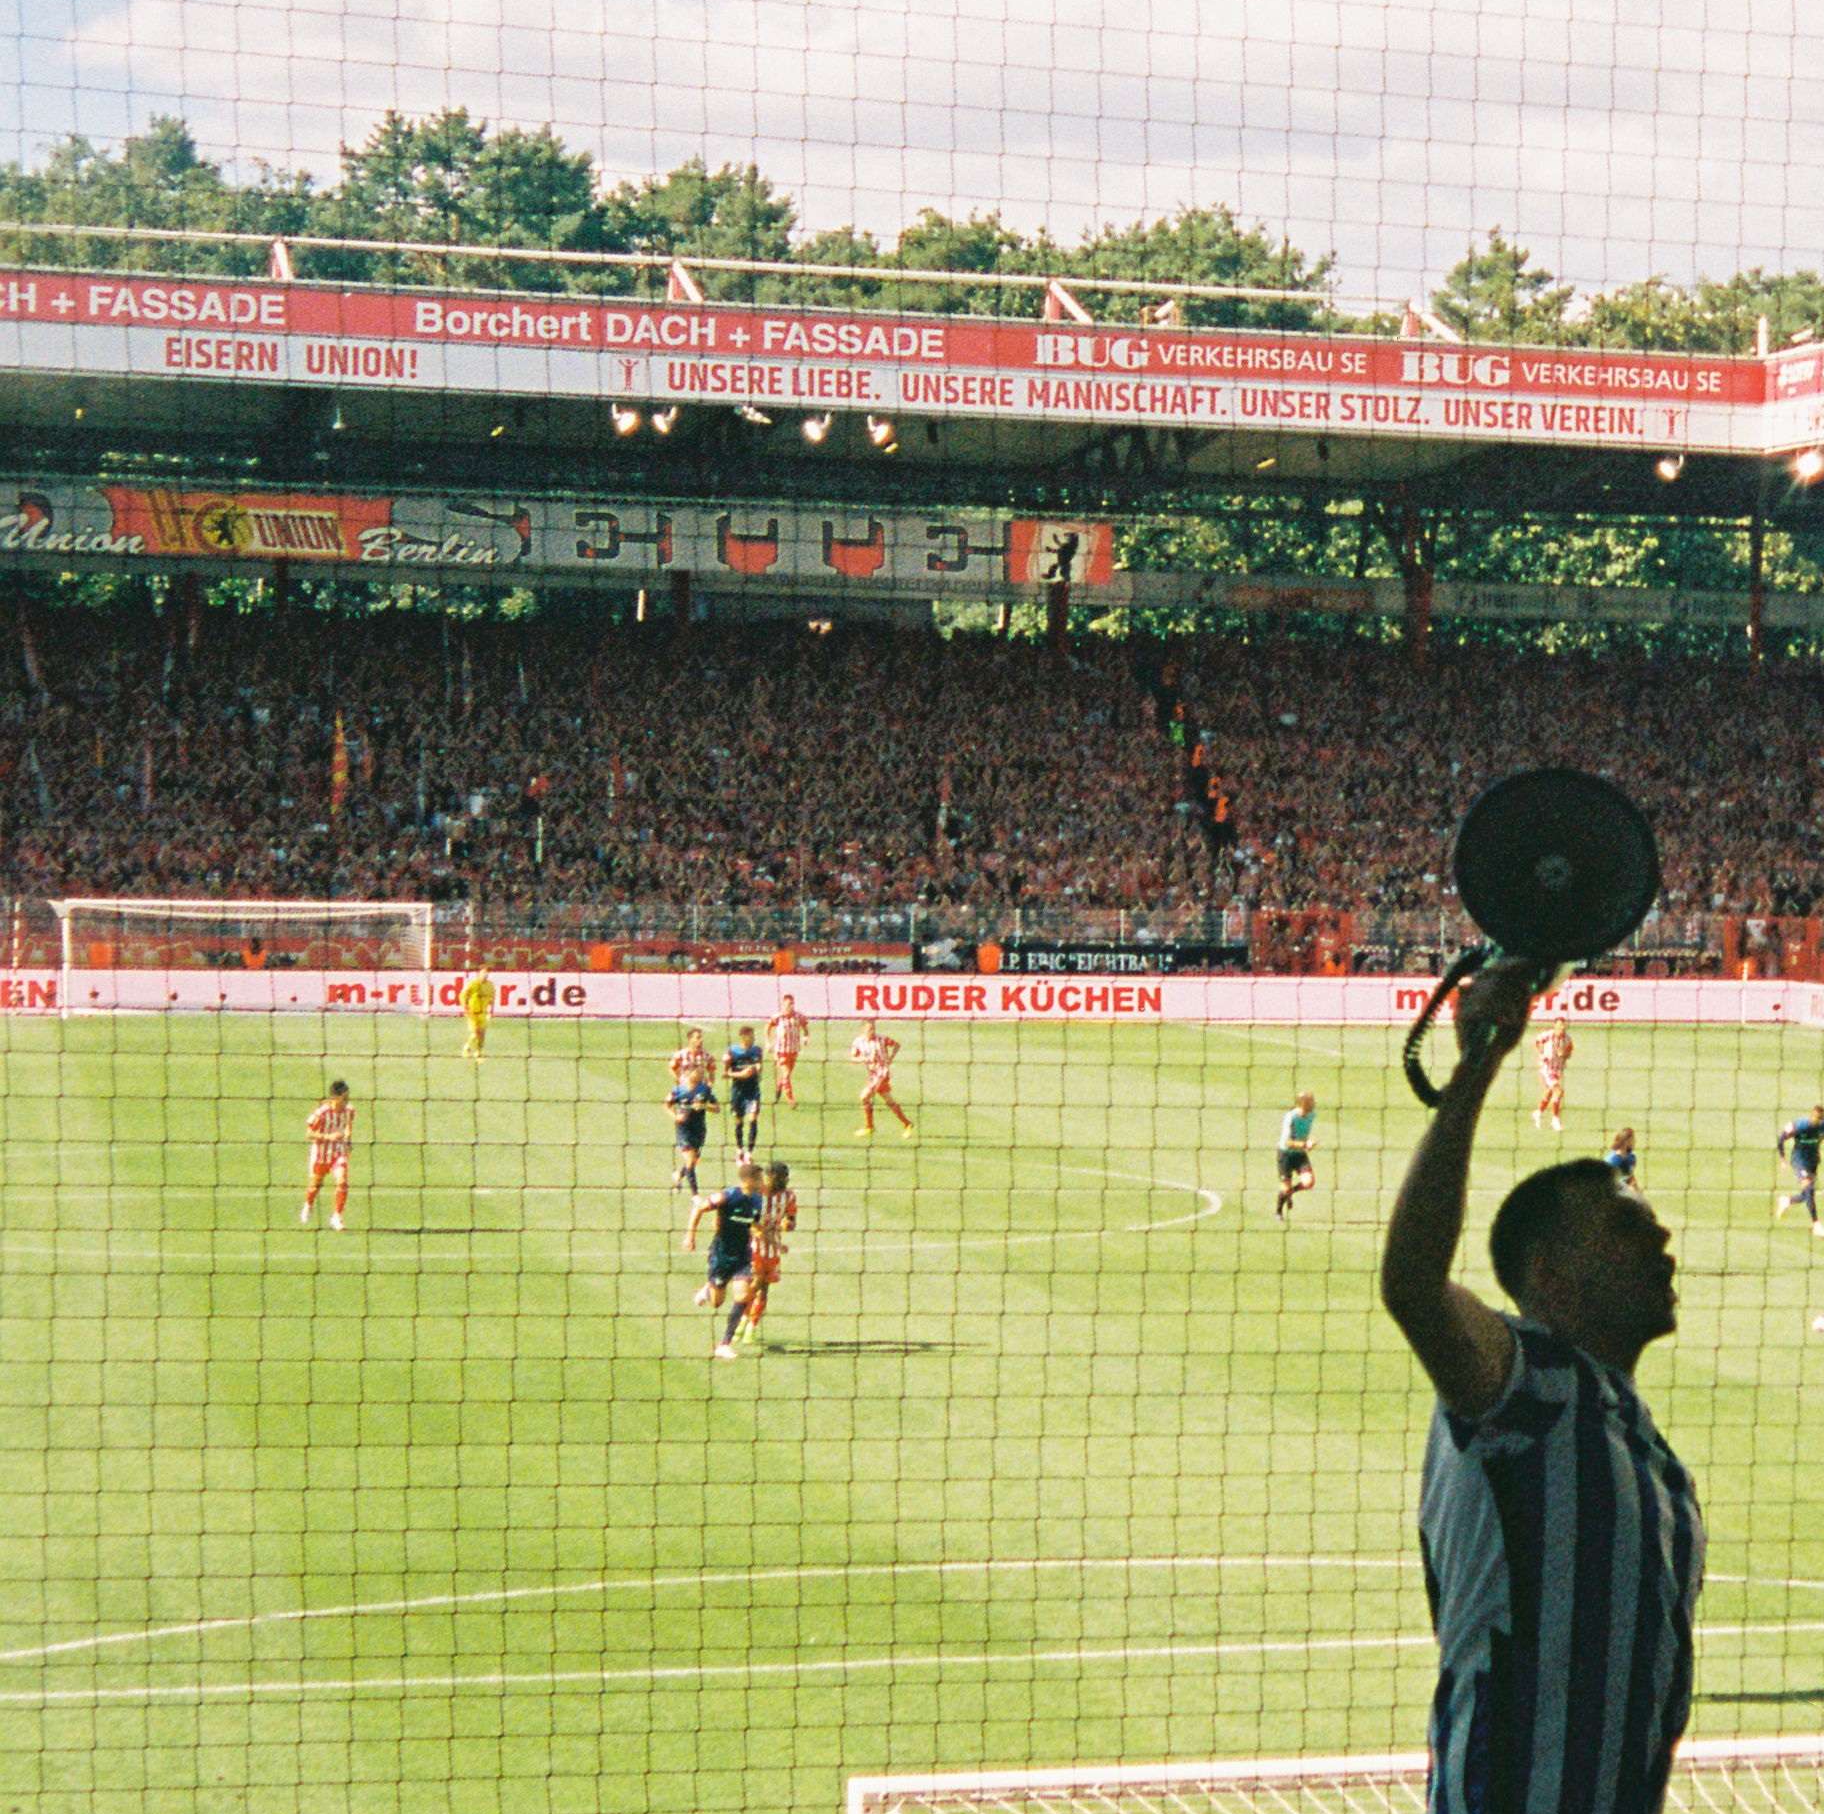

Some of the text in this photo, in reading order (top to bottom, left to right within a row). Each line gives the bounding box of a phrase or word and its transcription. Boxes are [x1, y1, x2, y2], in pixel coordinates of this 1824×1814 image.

[89, 285, 286, 325] FASSADE
[414, 301, 592, 342] Borchert
[605, 312, 716, 347] DACH
[763, 320, 945, 359] FASSADE
[165, 336, 418, 379] EISERN UNION!
[1034, 334, 1367, 374] BUG VERKEHRSBAU SE
[1401, 350, 1722, 393] BUG VERKEHRSBAU SE
[667, 361, 1644, 436] UNSERE LIEBE. UNSERE MANNSCHAFT. UNSER STOLZ. UNSER VEREIN.
[253, 512, 344, 553] UNION
[360, 526, 502, 565] Berlin
[327, 976, 587, 1008] m-rudr.de
[854, 979, 1163, 1014] RUDER KÜCHEN
